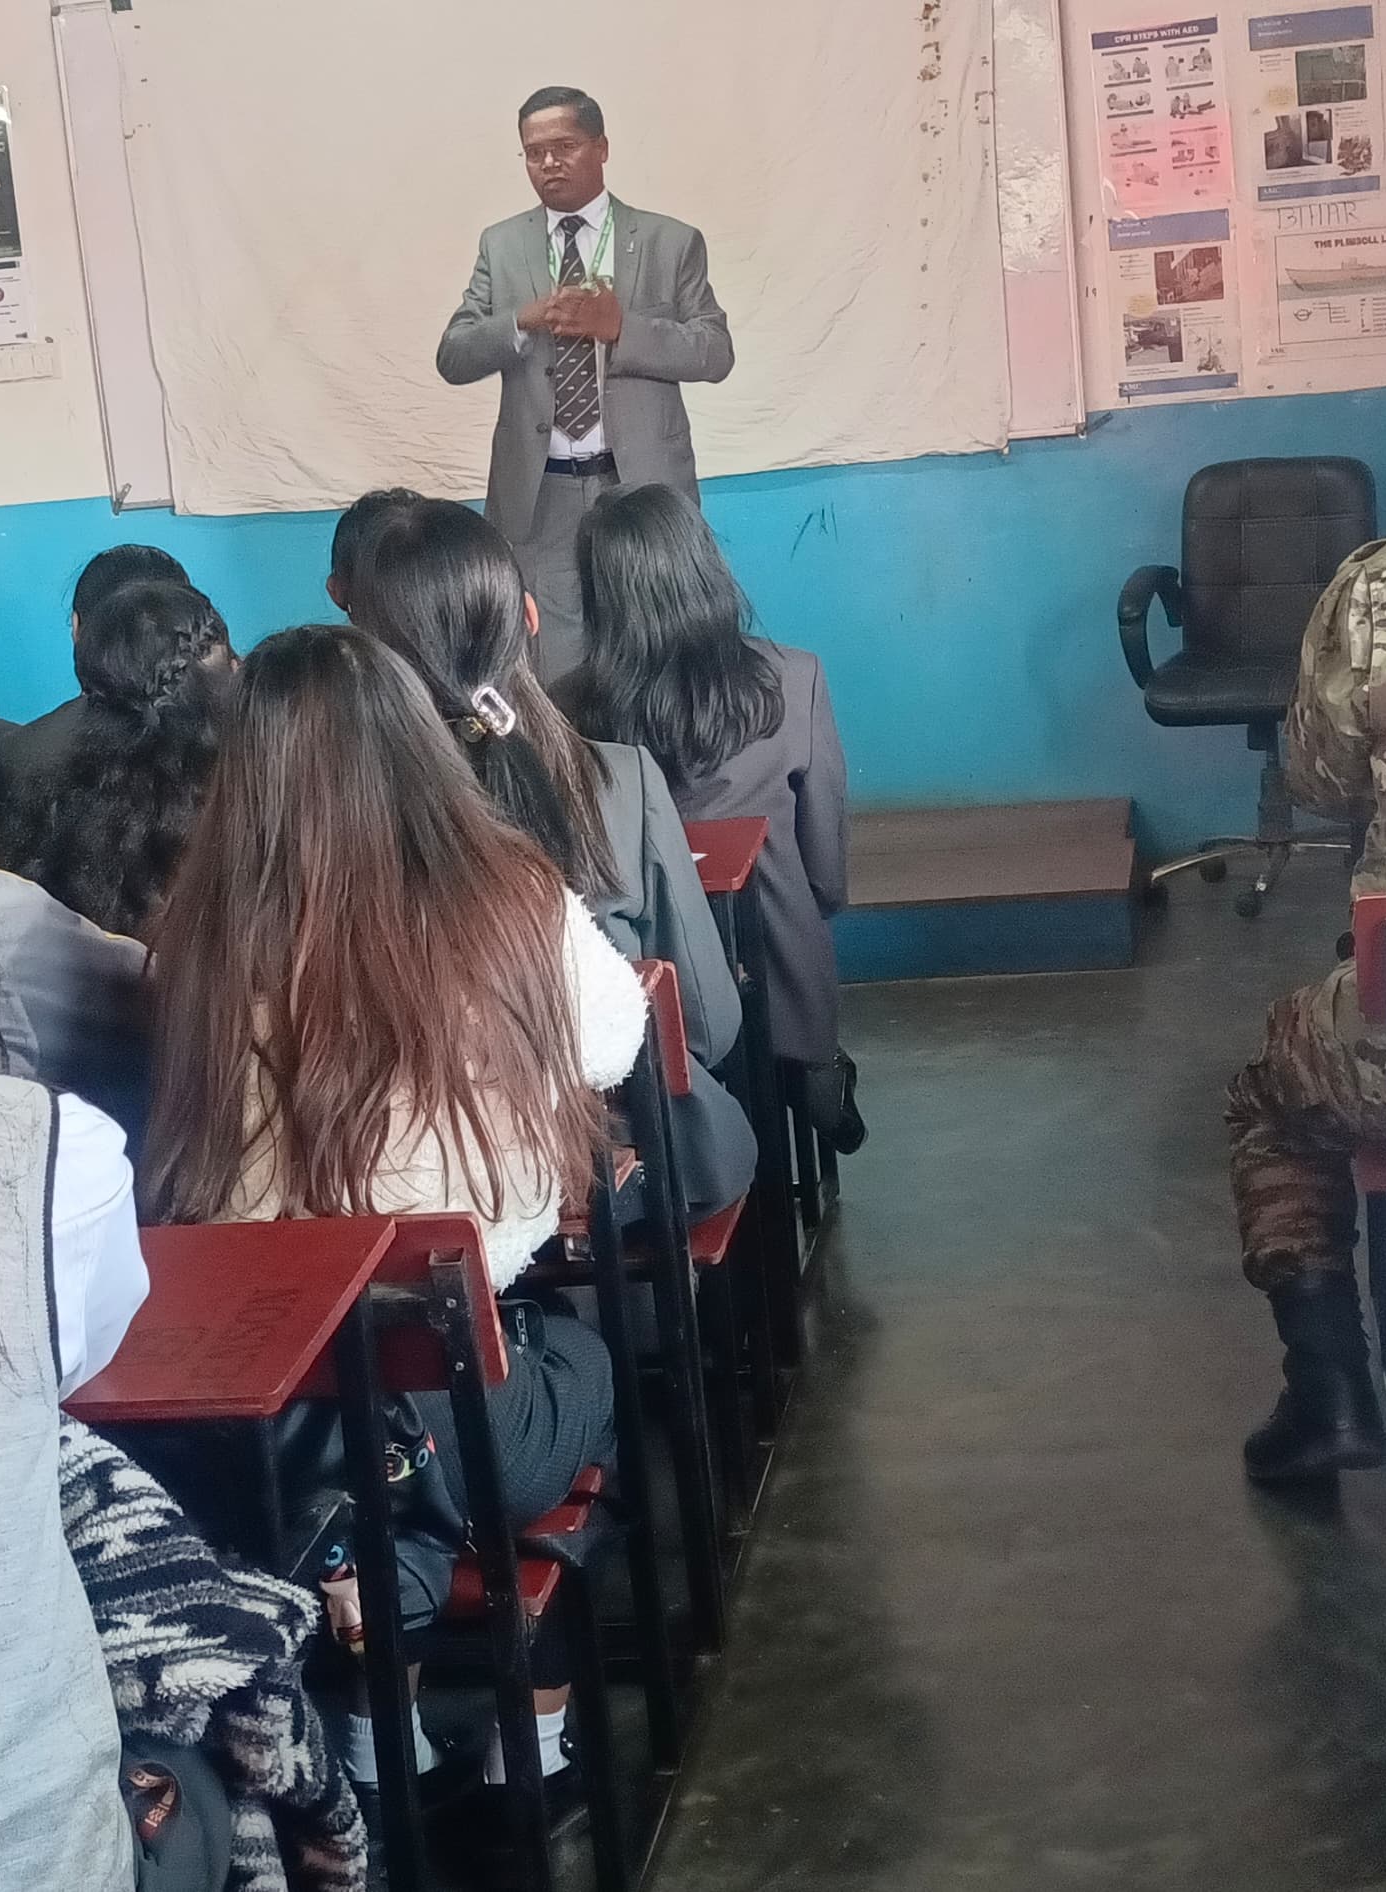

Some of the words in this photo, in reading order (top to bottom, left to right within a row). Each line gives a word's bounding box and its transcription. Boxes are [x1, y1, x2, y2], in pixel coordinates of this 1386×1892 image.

[1160, 27, 1181, 38] WITH
[1277, 200, 1358, 230] BIHAR
[1314, 238, 1333, 249] THE
